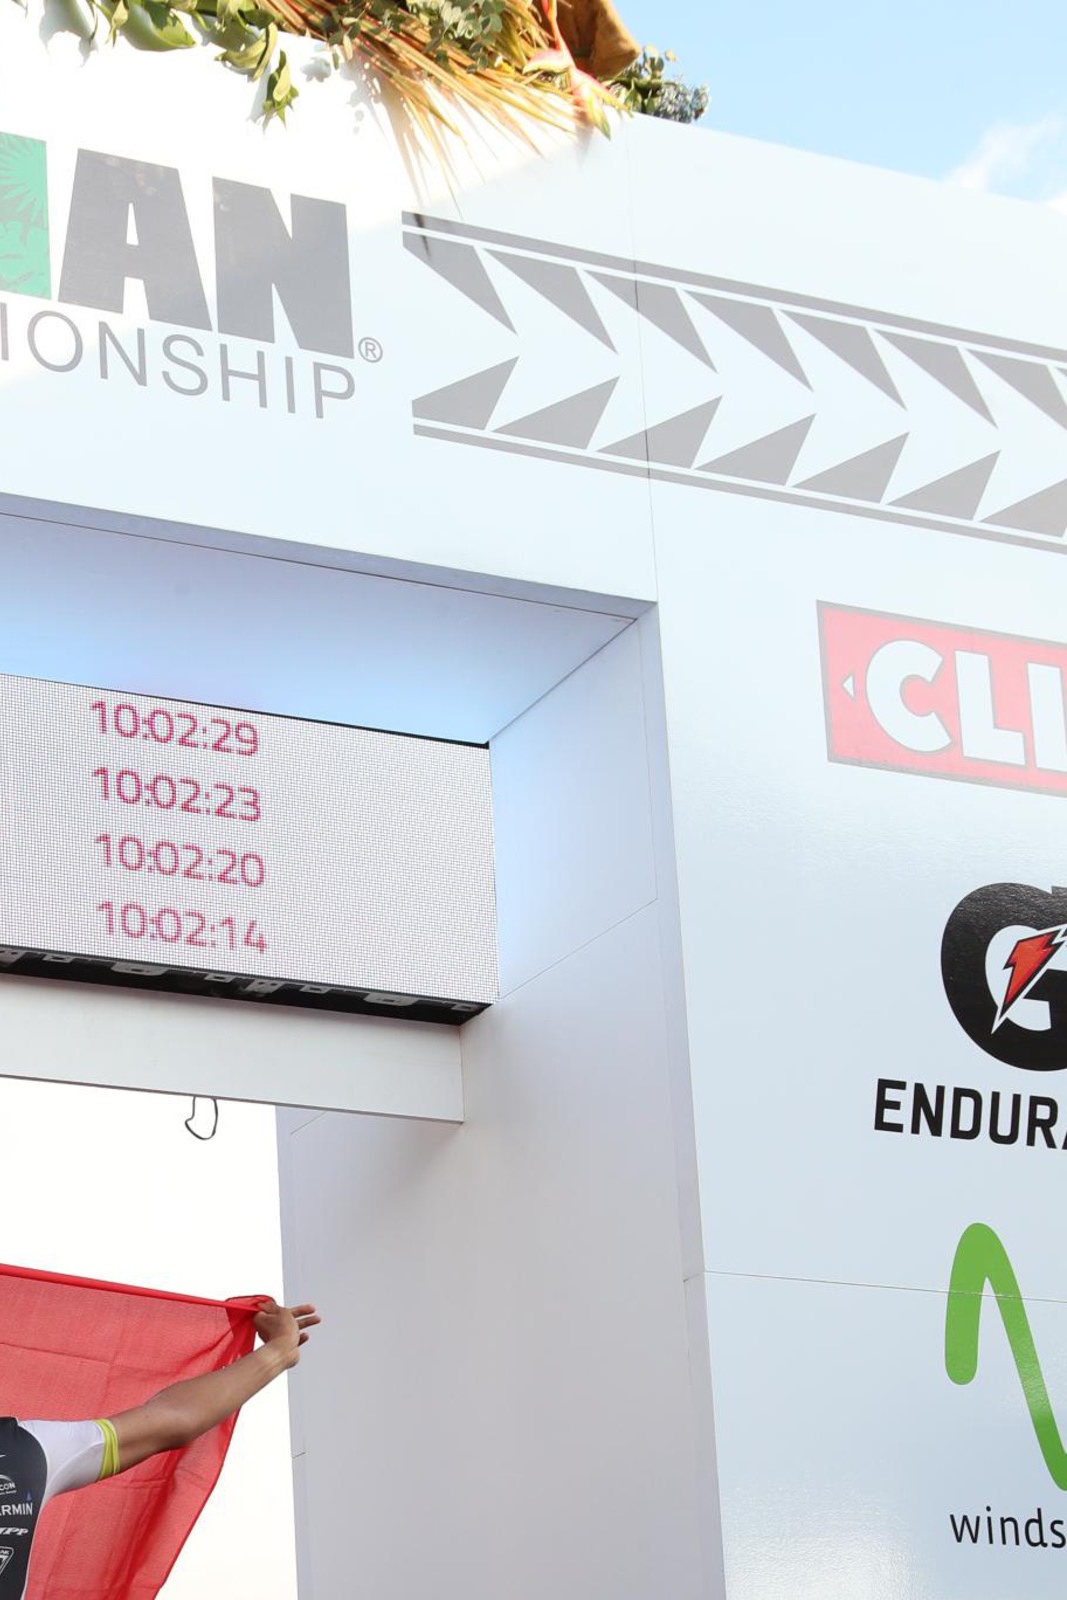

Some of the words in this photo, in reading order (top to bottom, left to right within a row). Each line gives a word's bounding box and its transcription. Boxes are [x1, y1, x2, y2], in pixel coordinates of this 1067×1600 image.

[90, 700, 259, 757] 10:02:29
[865, 639, 1067, 774] CLI
[92, 766, 261, 822] 10:02:23
[94, 833, 266, 888] 10:02:20
[96, 900, 268, 954] 10:02:14
[873, 1078, 1067, 1151] ENDUR
[949, 1506, 1067, 1549] winds
